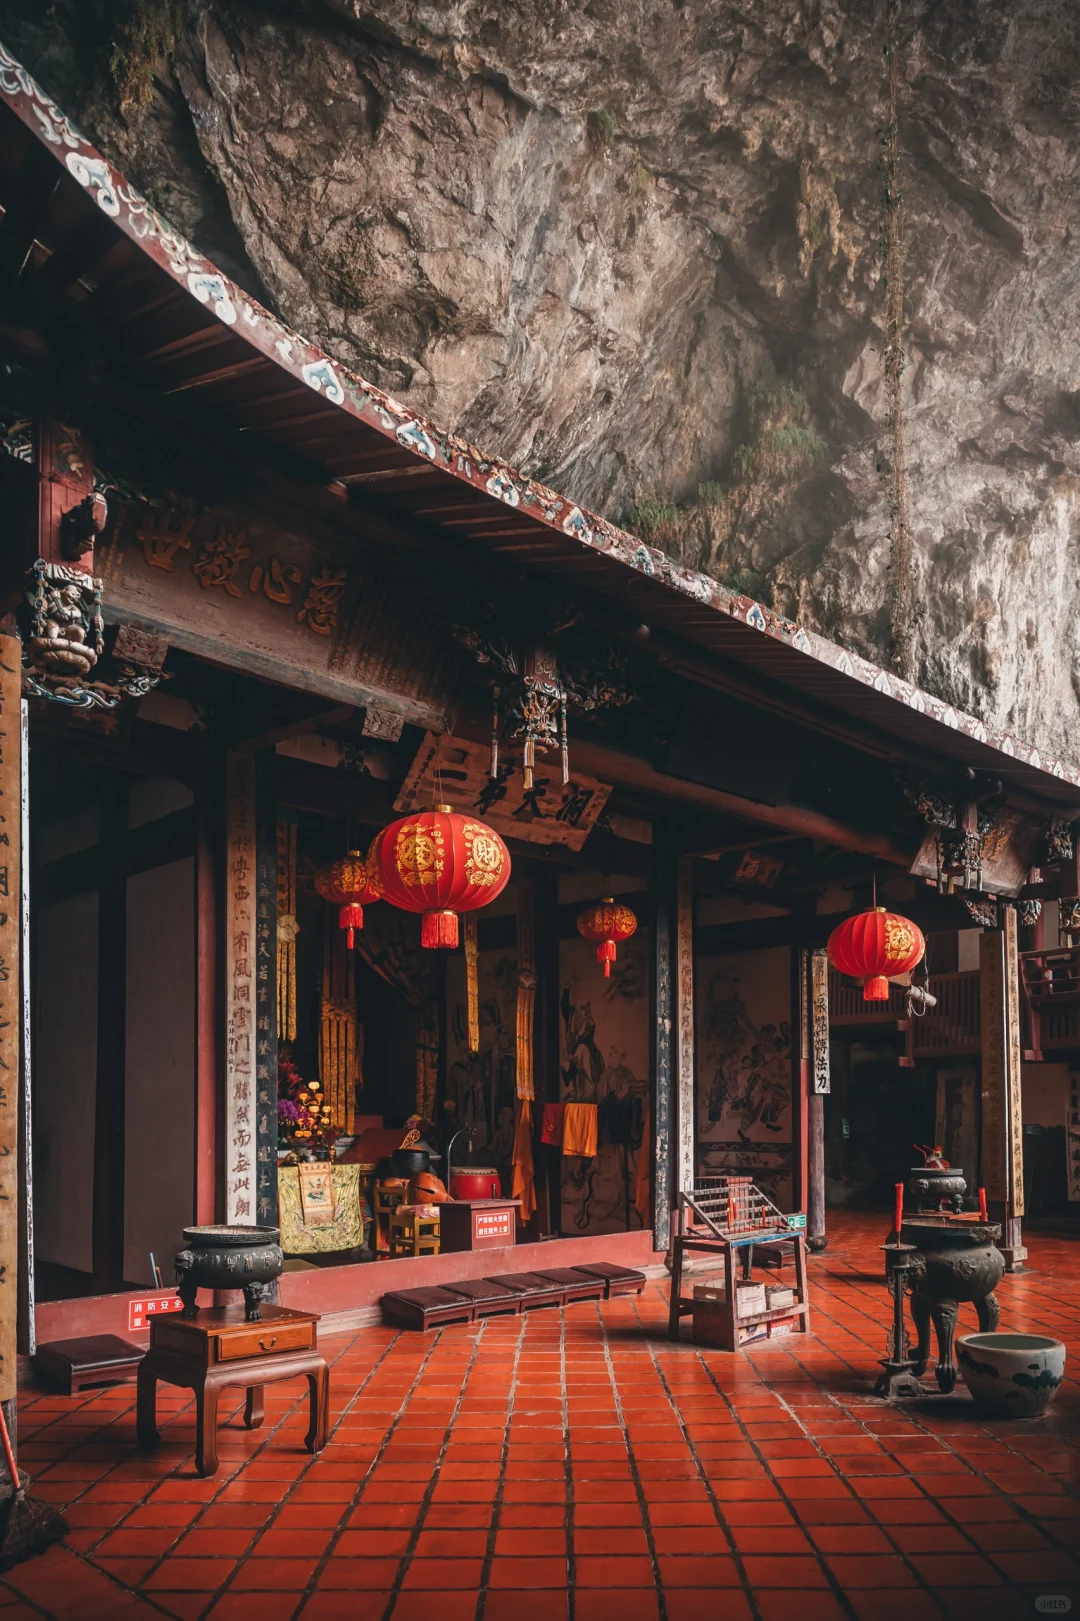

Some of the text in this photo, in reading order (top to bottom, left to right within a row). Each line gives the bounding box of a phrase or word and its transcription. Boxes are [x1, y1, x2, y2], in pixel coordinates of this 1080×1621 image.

[434, 760, 595, 827] 洞天第一
[134, 1300, 181, 1312] 消防安全
[133, 1317, 152, 1328] 重
